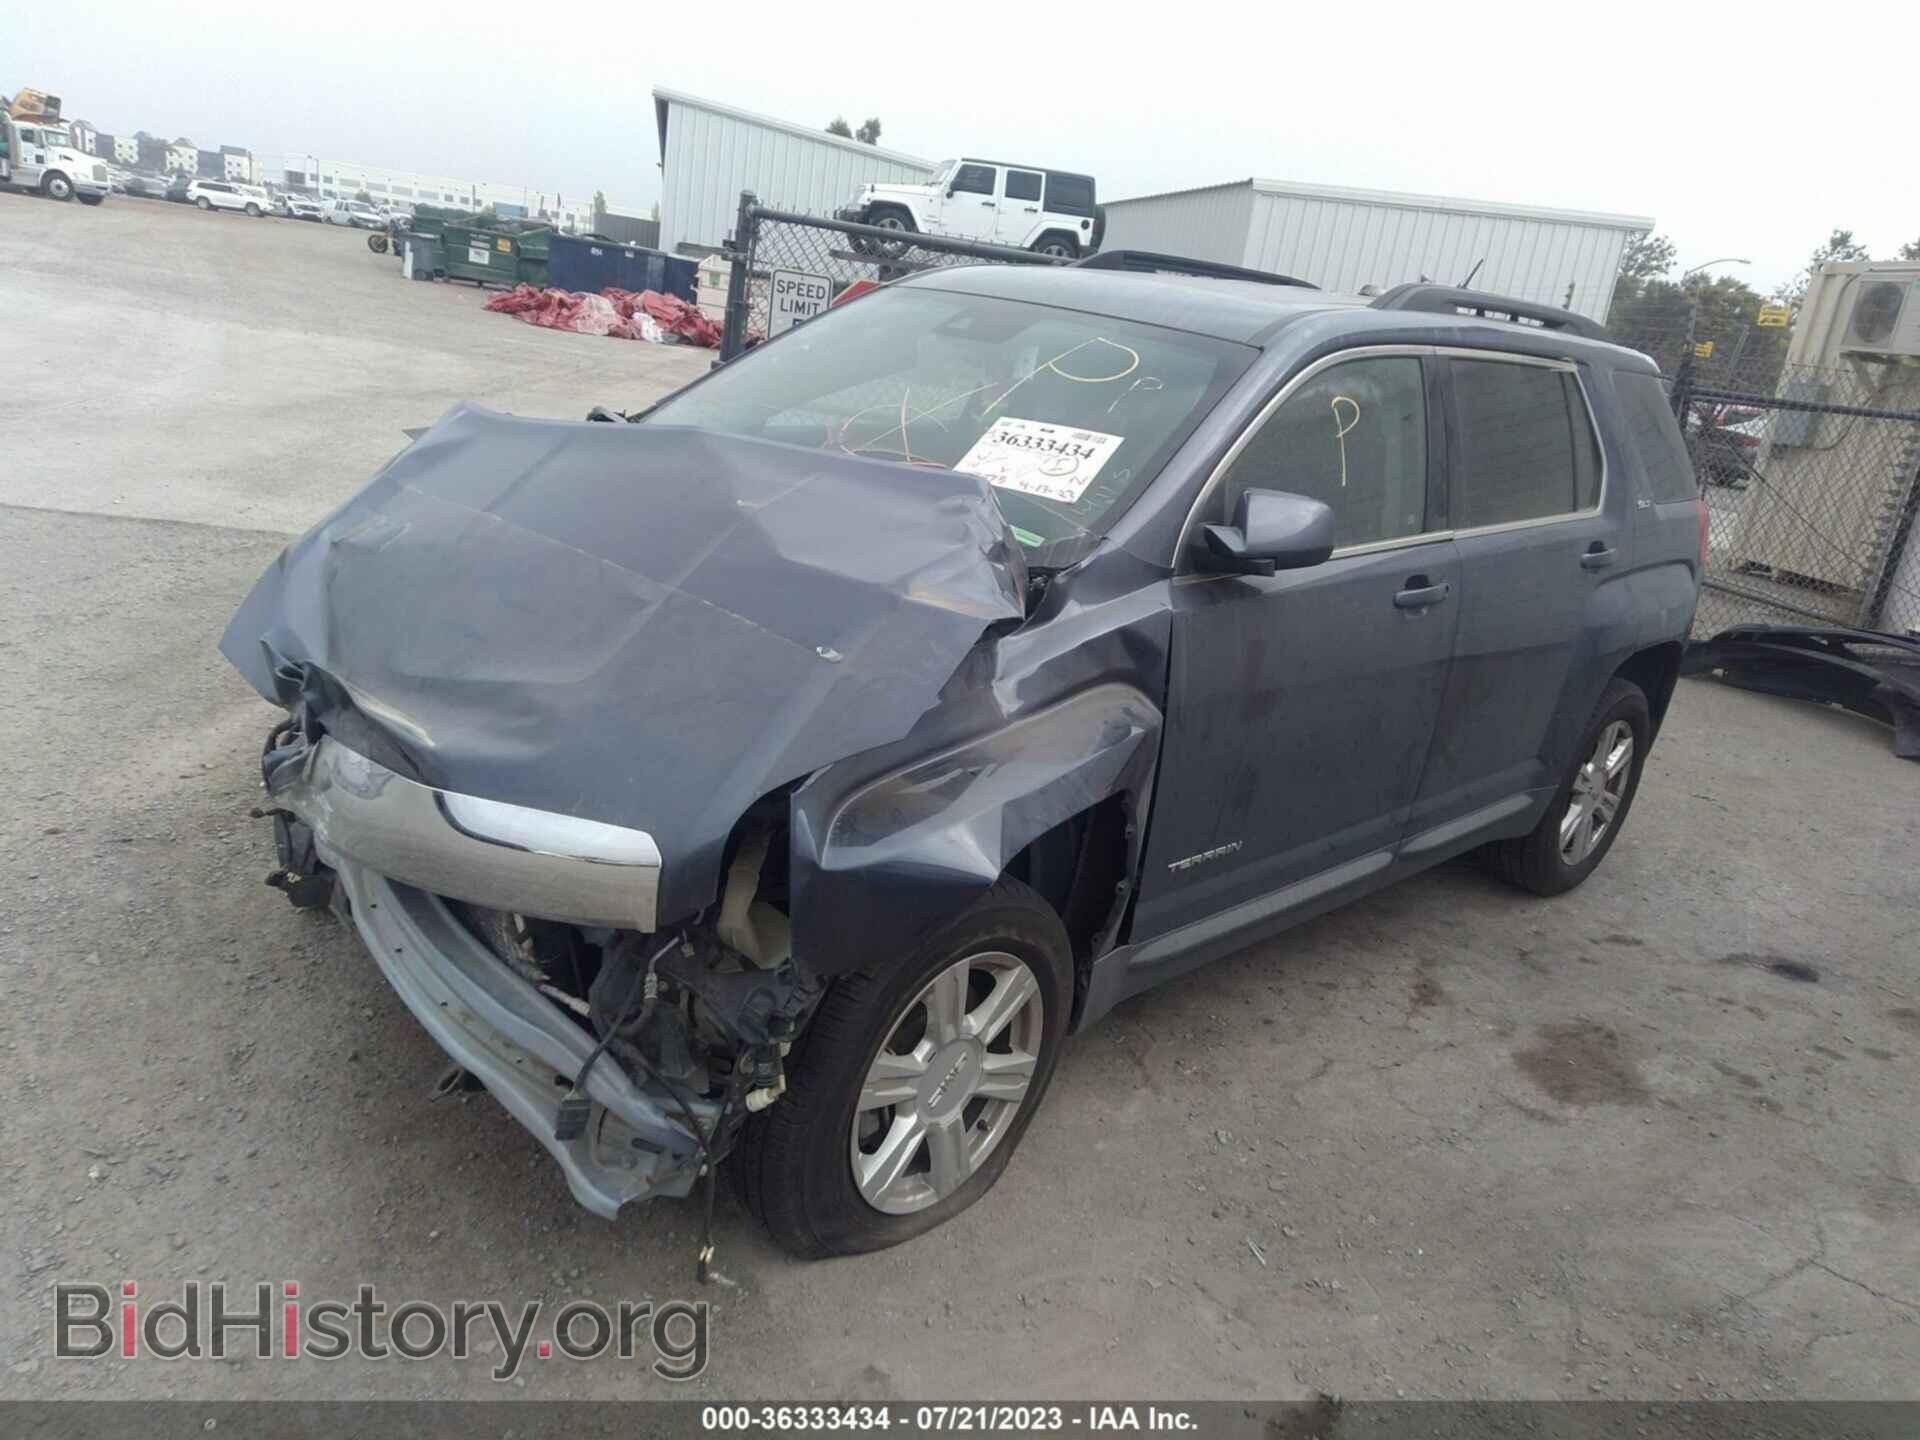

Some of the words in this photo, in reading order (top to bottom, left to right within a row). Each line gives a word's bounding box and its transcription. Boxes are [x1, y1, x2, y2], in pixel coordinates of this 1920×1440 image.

[775, 279, 827, 301] SPEED
[780, 298, 821, 317] LIMIT
[992, 431, 1096, 461] 36333434
[1331, 396, 1361, 487] P
[1167, 840, 1244, 873] TERRAIN
